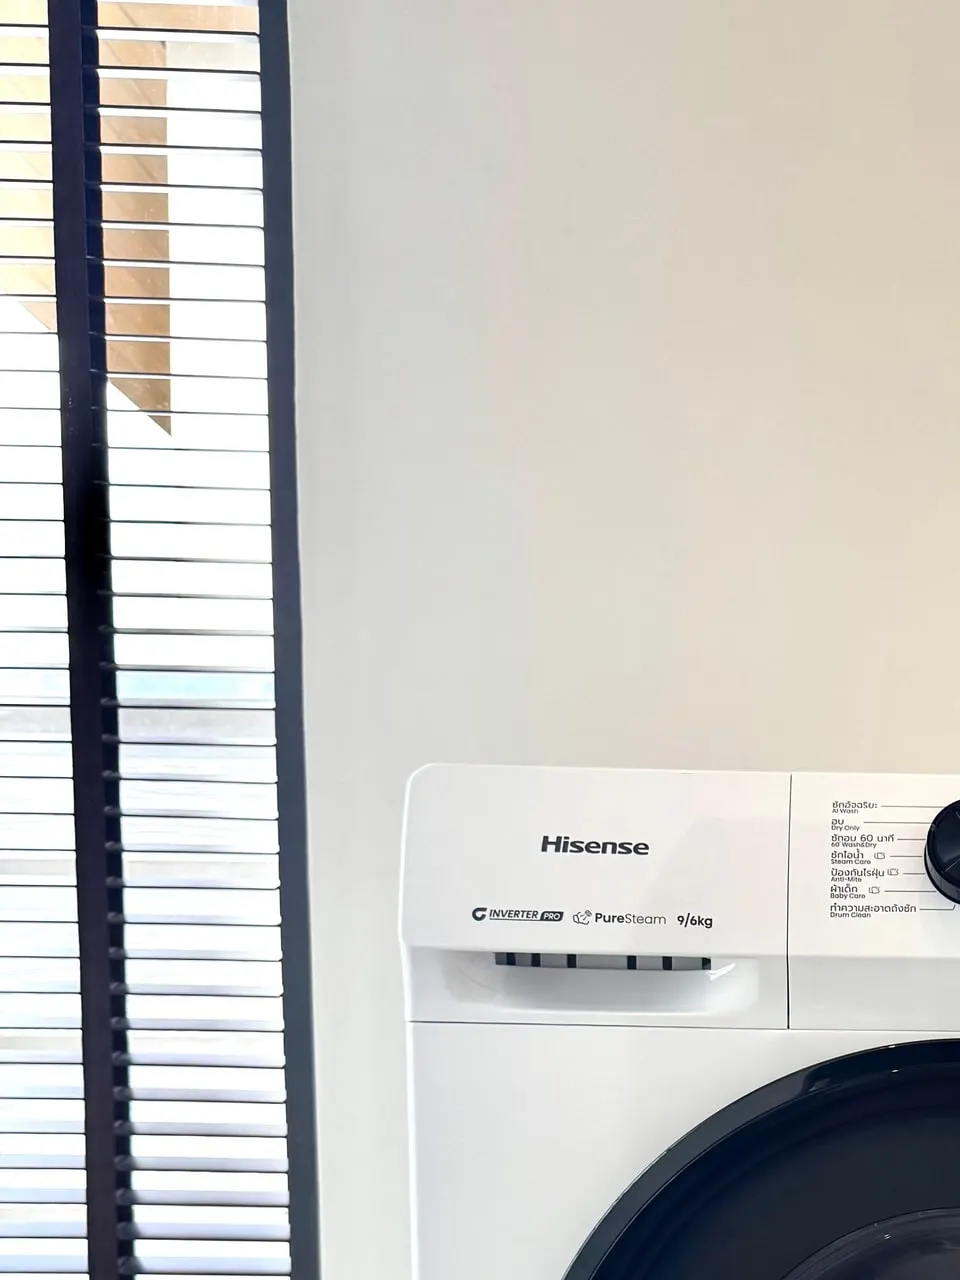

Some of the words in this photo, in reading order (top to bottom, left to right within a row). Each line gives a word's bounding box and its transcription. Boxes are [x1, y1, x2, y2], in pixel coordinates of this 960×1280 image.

[831, 833, 857, 842] ซักอบ
[860, 834, 874, 842] 60
[877, 833, 895, 843] นาที
[541, 836, 649, 855] Hisense
[830, 892, 848, 900] Baby
[489, 908, 539, 920] INVERTER
[543, 912, 561, 922] PRO
[594, 912, 667, 926] PureSteam
[677, 914, 713, 929] 9/6kg
